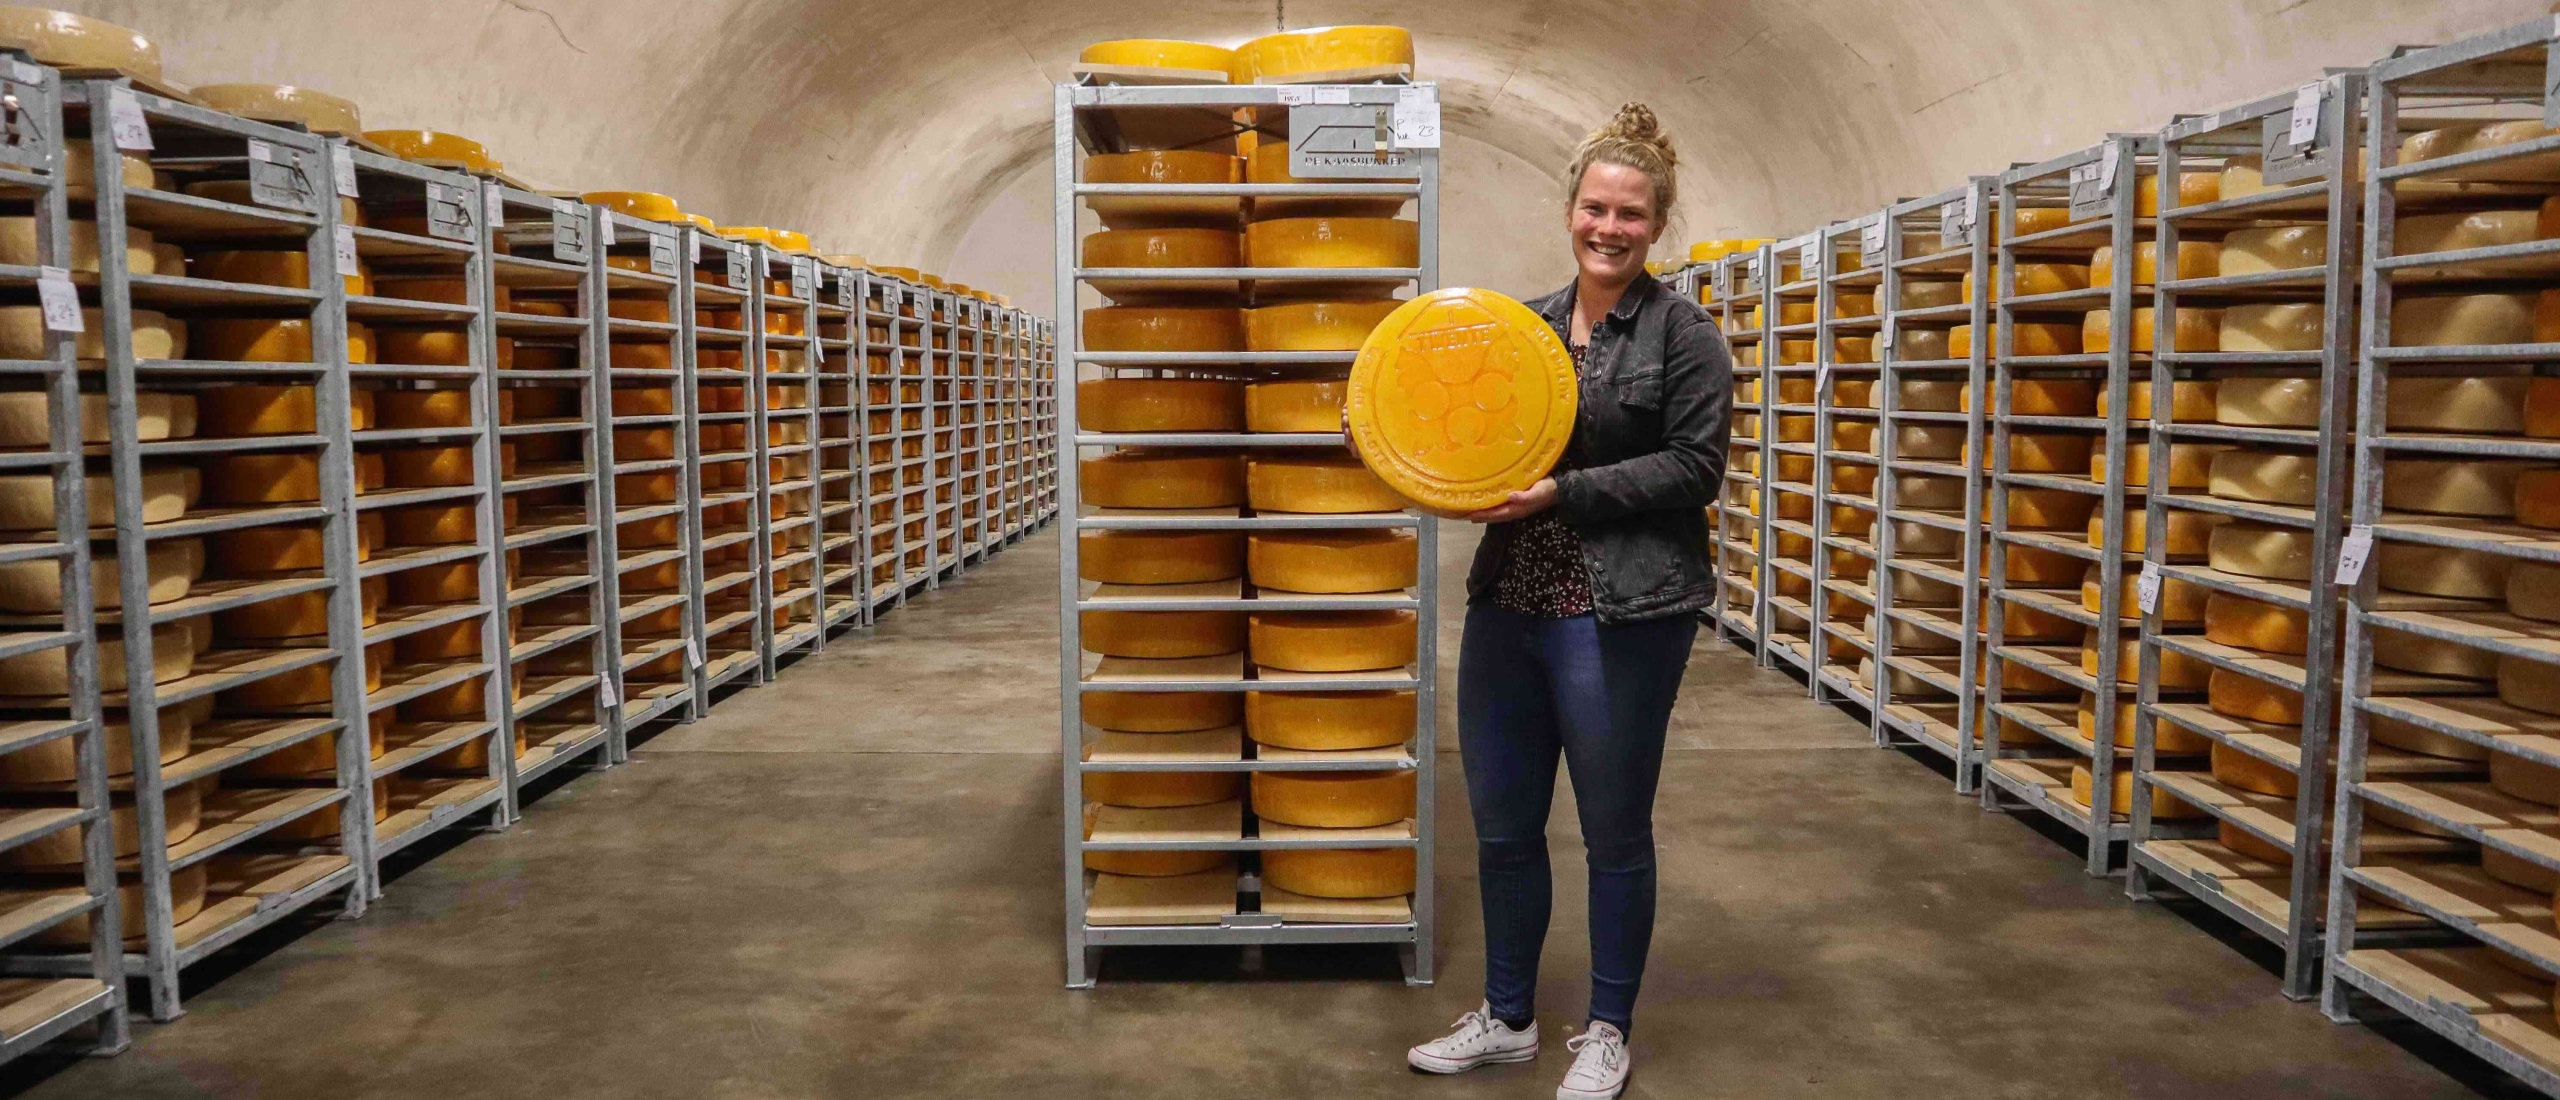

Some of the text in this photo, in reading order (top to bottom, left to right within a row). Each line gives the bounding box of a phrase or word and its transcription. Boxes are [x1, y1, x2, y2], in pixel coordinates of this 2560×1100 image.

[1418, 124, 1435, 138] 23
[1305, 157, 1406, 167] DE KAASBUNKER
[1359, 420, 1390, 471] TASTE
[1413, 480, 1514, 505] TRADITIONAL
